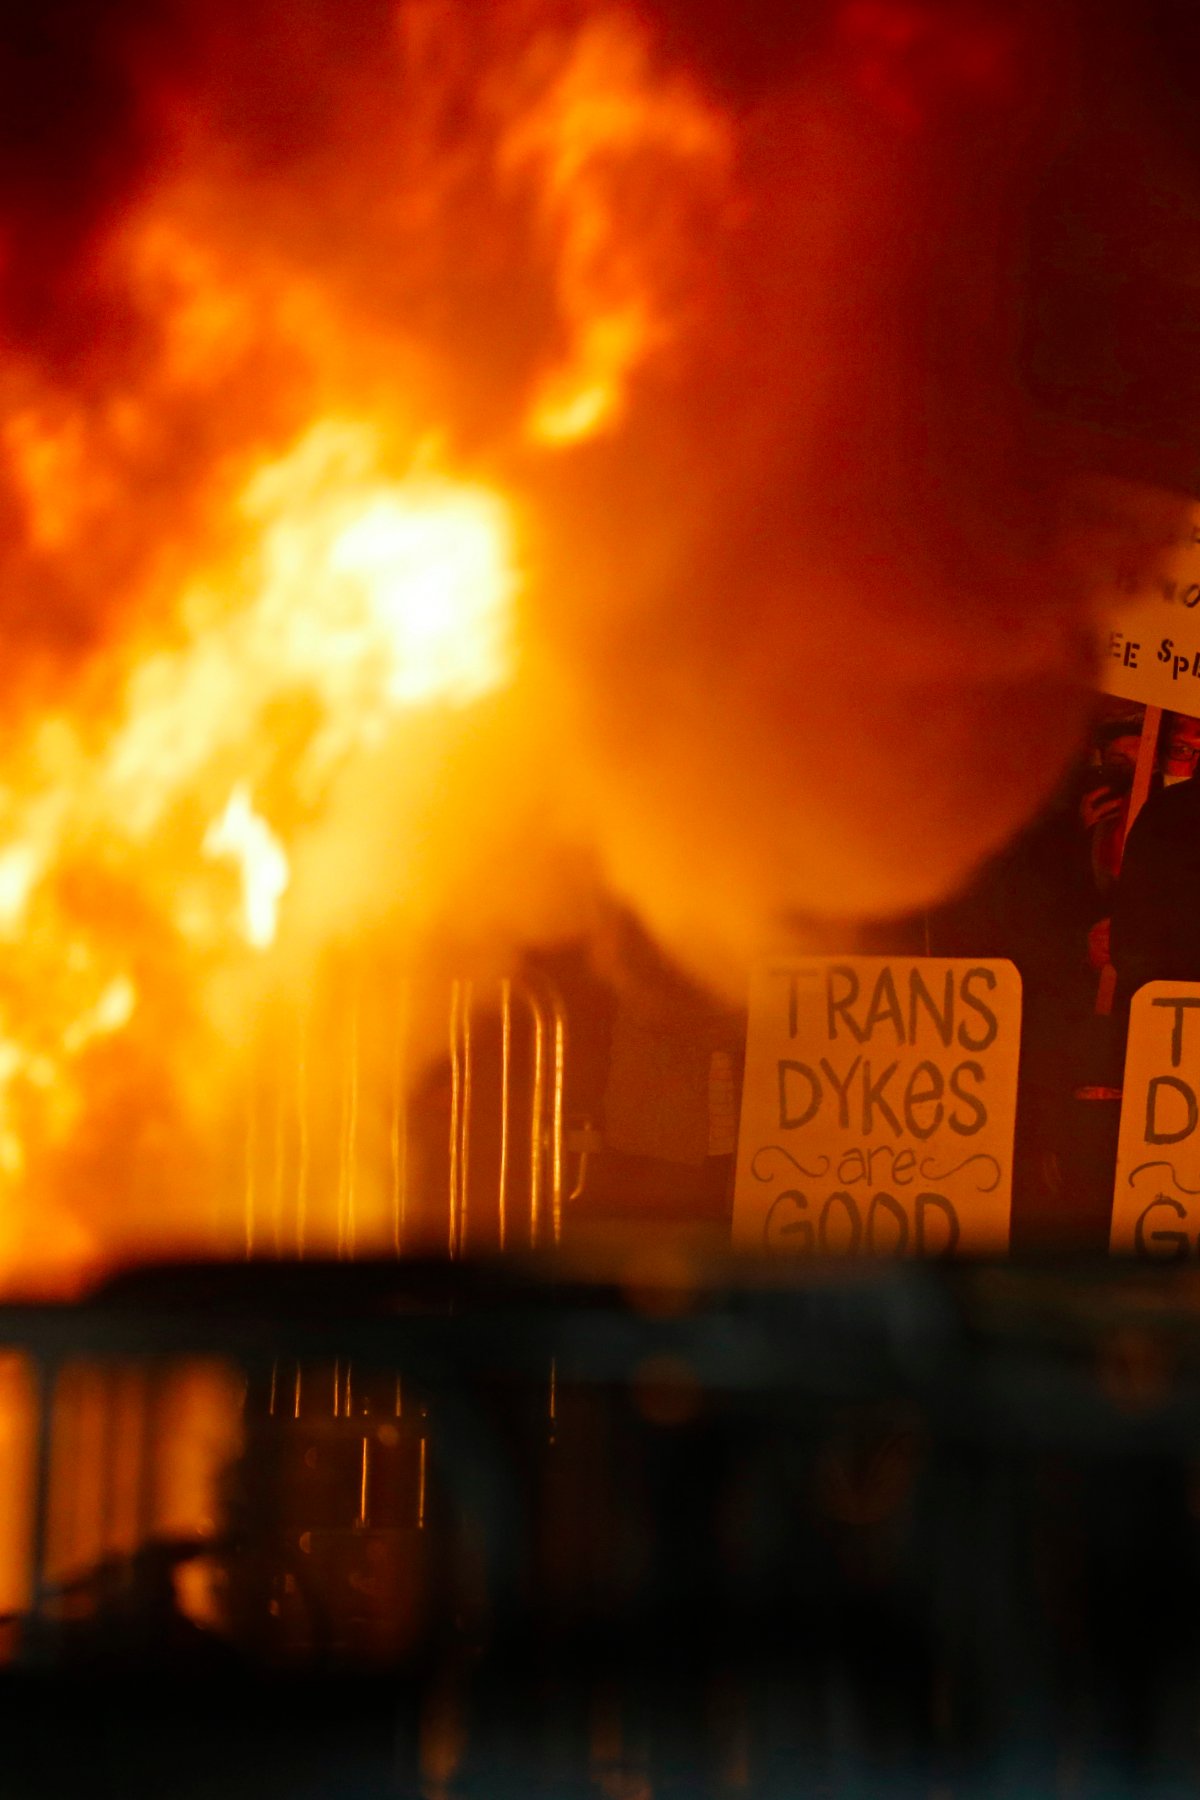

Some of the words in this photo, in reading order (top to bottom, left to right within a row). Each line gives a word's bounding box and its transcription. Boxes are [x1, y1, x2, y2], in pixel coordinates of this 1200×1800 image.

[772, 964, 999, 1052] TRANS
[837, 1145, 917, 1187] are
[763, 1190, 961, 1258] GOOD
